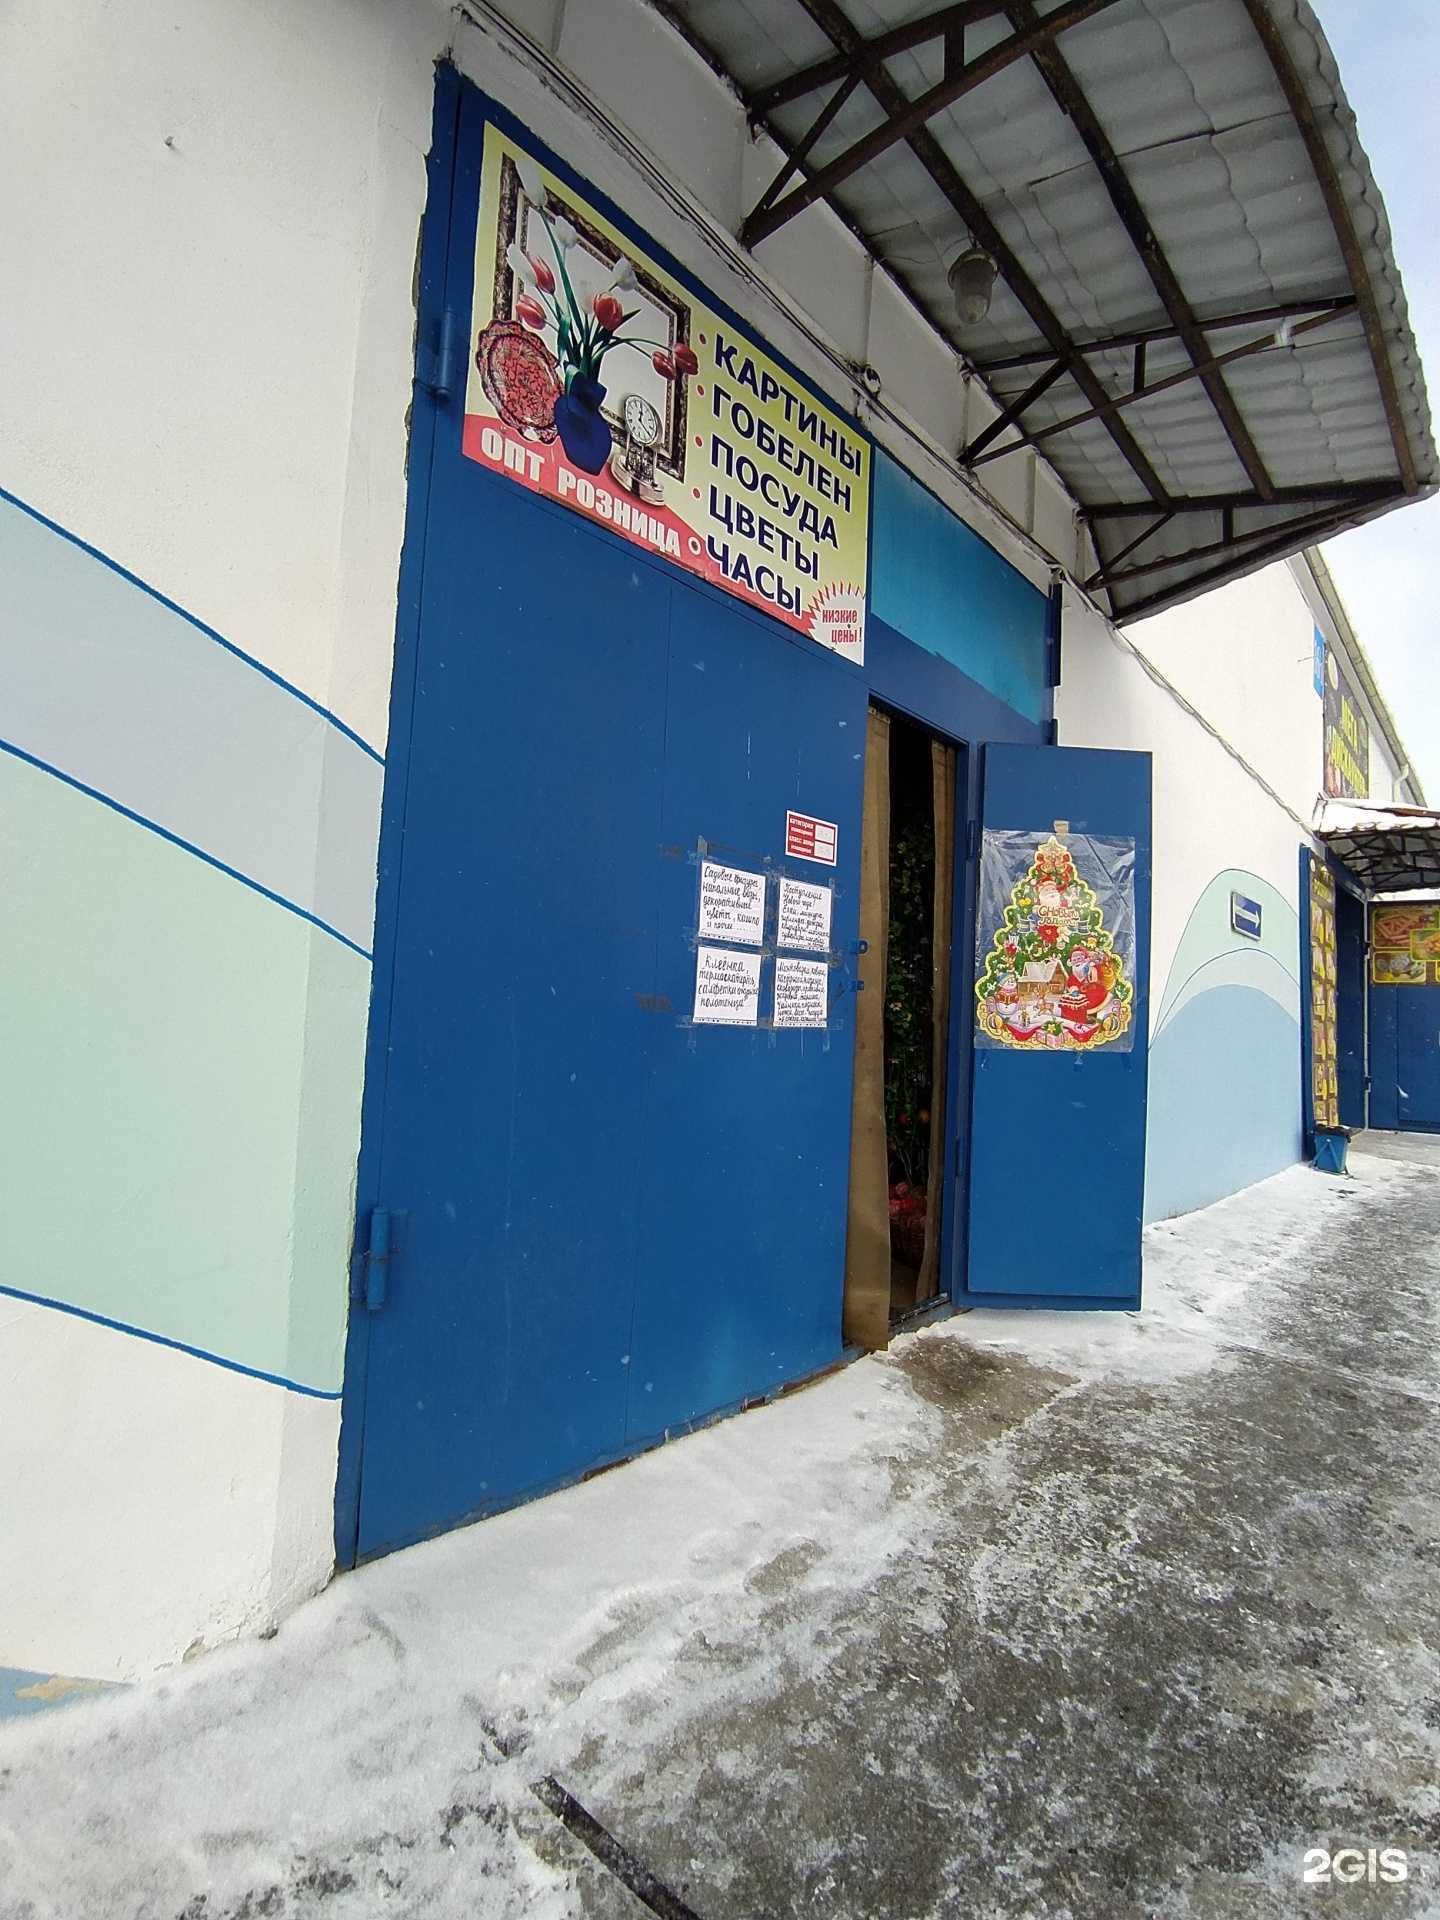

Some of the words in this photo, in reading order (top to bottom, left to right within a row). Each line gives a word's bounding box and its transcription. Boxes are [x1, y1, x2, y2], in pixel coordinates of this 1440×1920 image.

[713, 384, 850, 513] ГОБЕЛЕН
[715, 333, 861, 477] КАРТИНЫ
[482, 427, 544, 482] ОПТ
[558, 466, 681, 557] РОЗНИЦА
[709, 484, 818, 580] ЦВЕТЫ
[711, 434, 838, 549] ПОСУДА
[707, 535, 801, 616] ЧАСЫ
